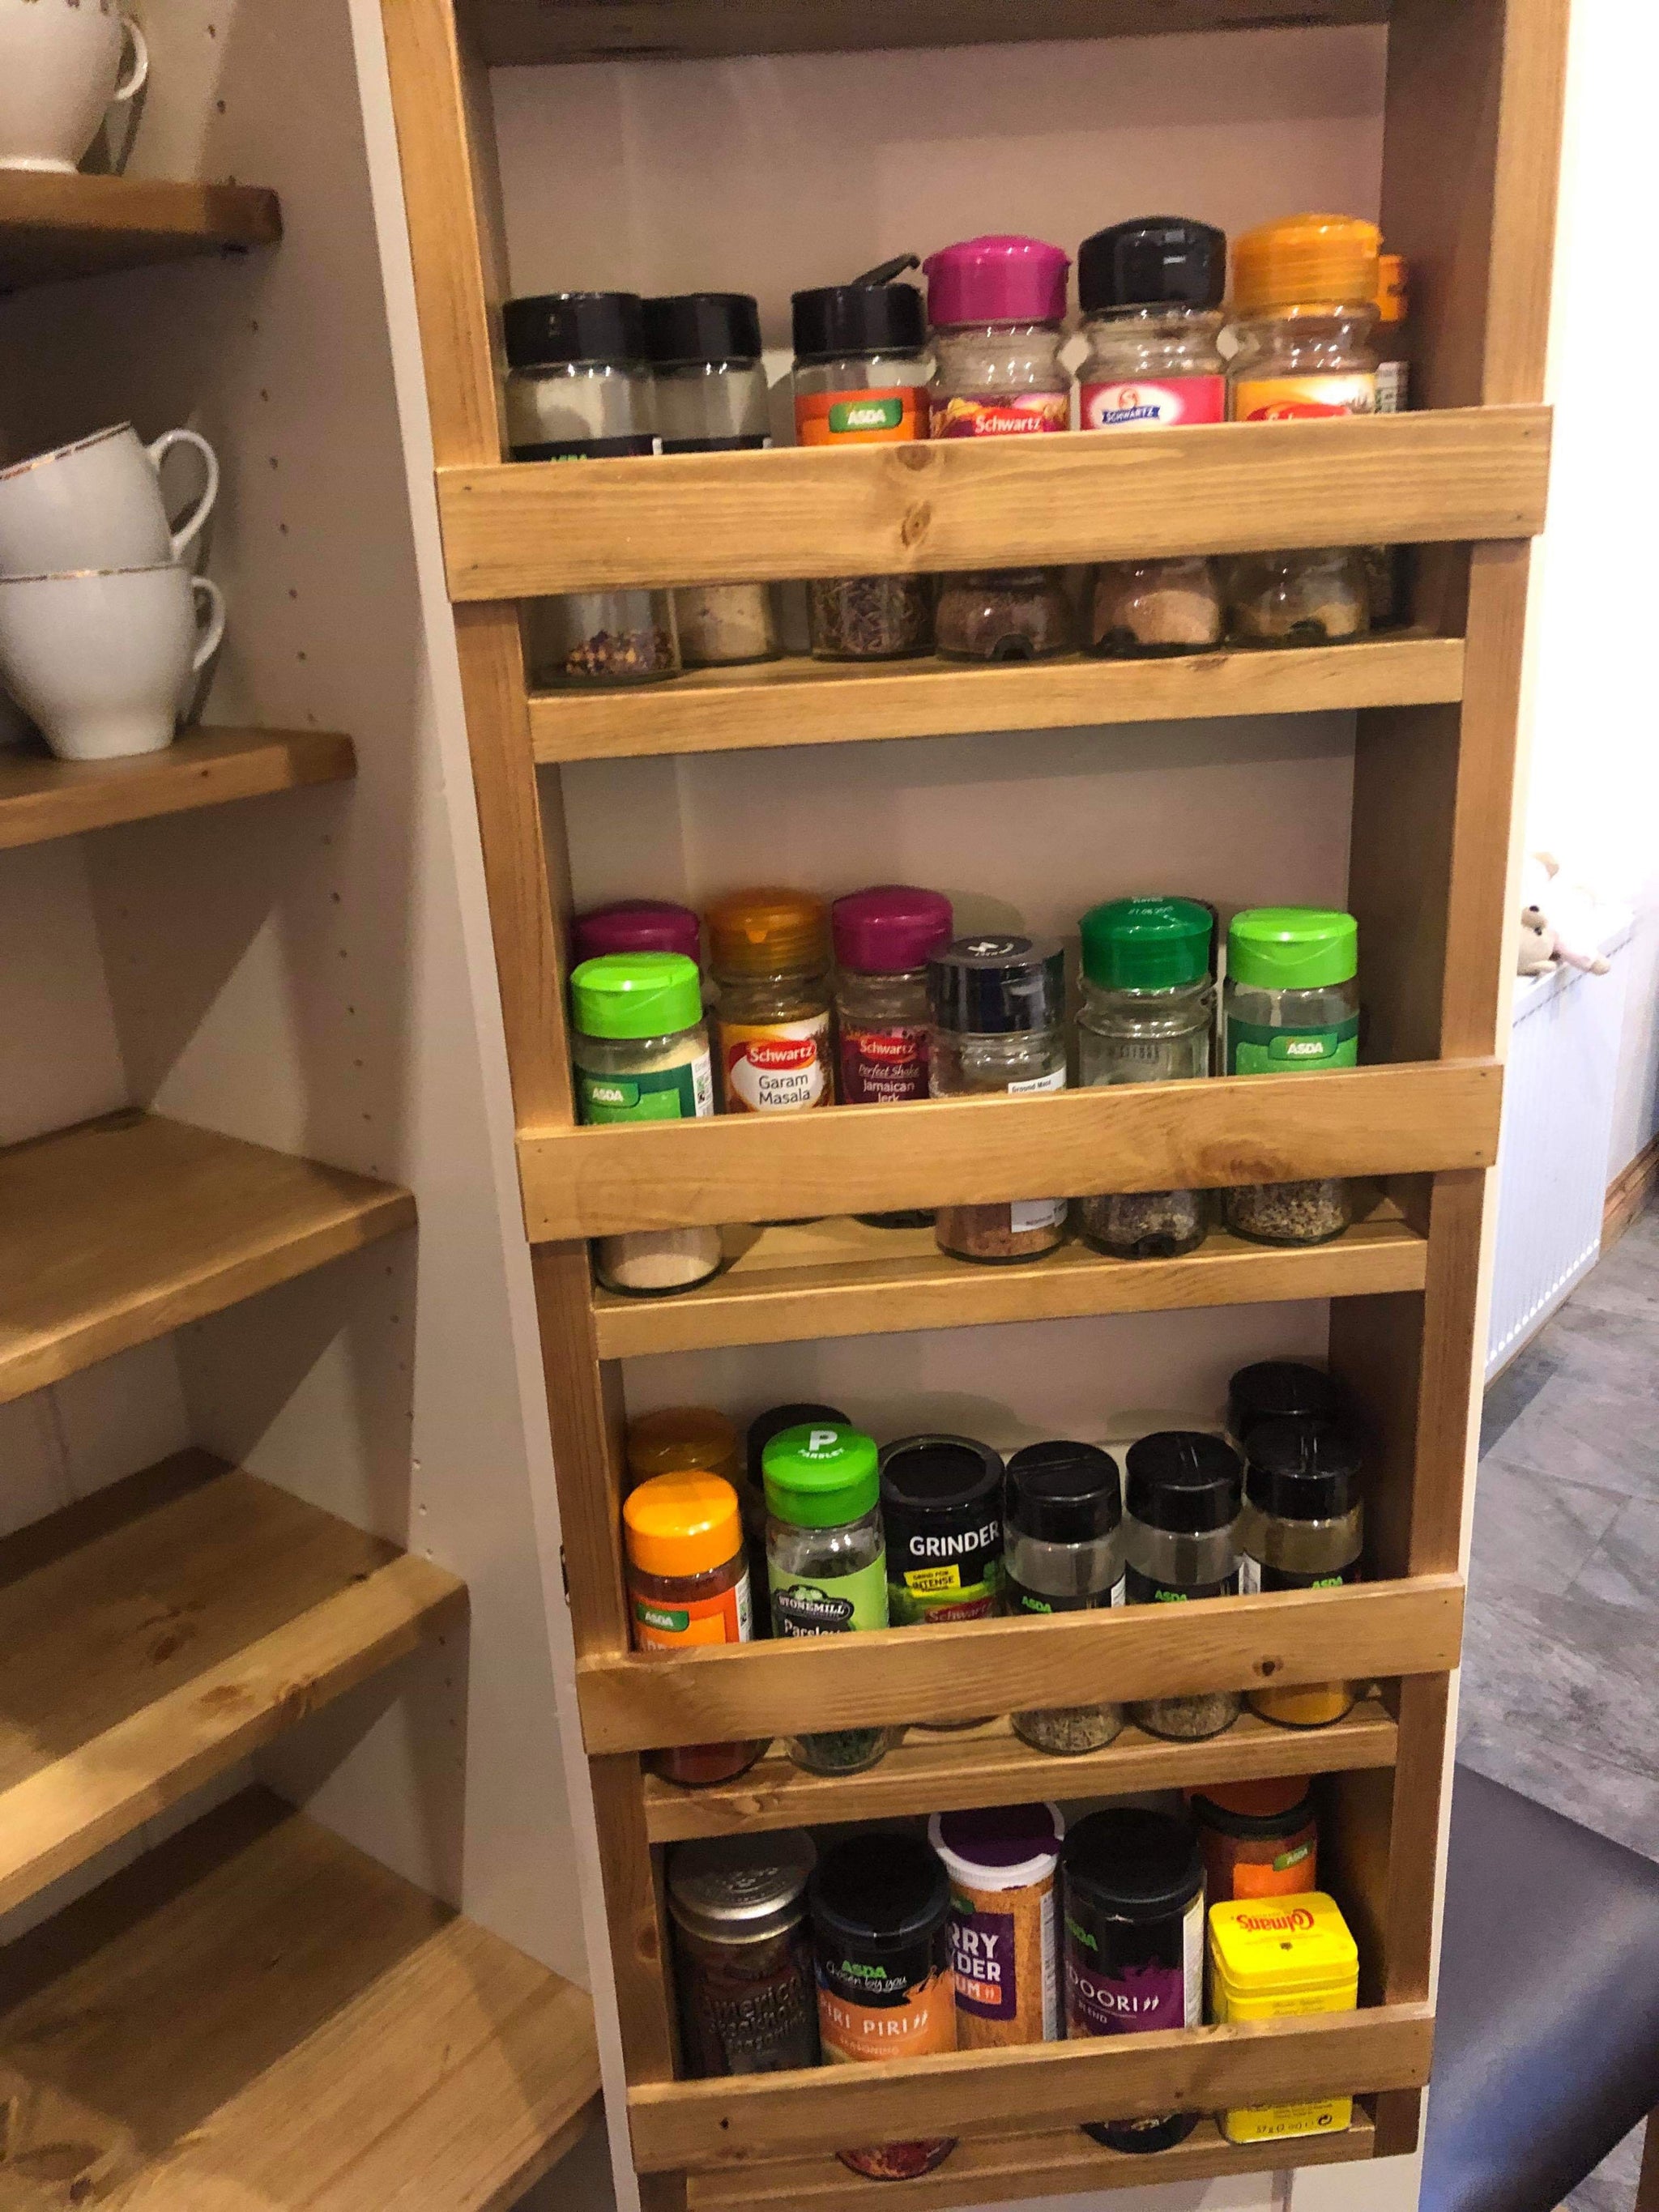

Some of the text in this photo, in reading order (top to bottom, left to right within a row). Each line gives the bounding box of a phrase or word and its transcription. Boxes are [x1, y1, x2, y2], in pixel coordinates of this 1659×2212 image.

[847, 409, 886, 425] ASDA
[975, 415, 1042, 433] Schwartz
[749, 1046, 812, 1063] Schwartz
[859, 1039, 916, 1055] Schwartz
[1286, 1042, 1324, 1055] ASDA
[859, 1063, 920, 1079] Perfect Shake
[758, 1073, 808, 1090] Garam
[864, 1078, 915, 1093] Jamaican
[591, 1086, 624, 1102] ASDA
[759, 1089, 811, 1106] Masala
[808, 1430, 838, 1451] P
[909, 1519, 1000, 1557] GRINDER
[778, 1595, 845, 1614] STONEMILL
[1021, 1595, 1052, 1614] ASDA
[842, 1959, 888, 1980] ASDA
[864, 1975, 882, 1994] by
[883, 1975, 908, 1993] you
[863, 2017, 908, 2037] PIRI
